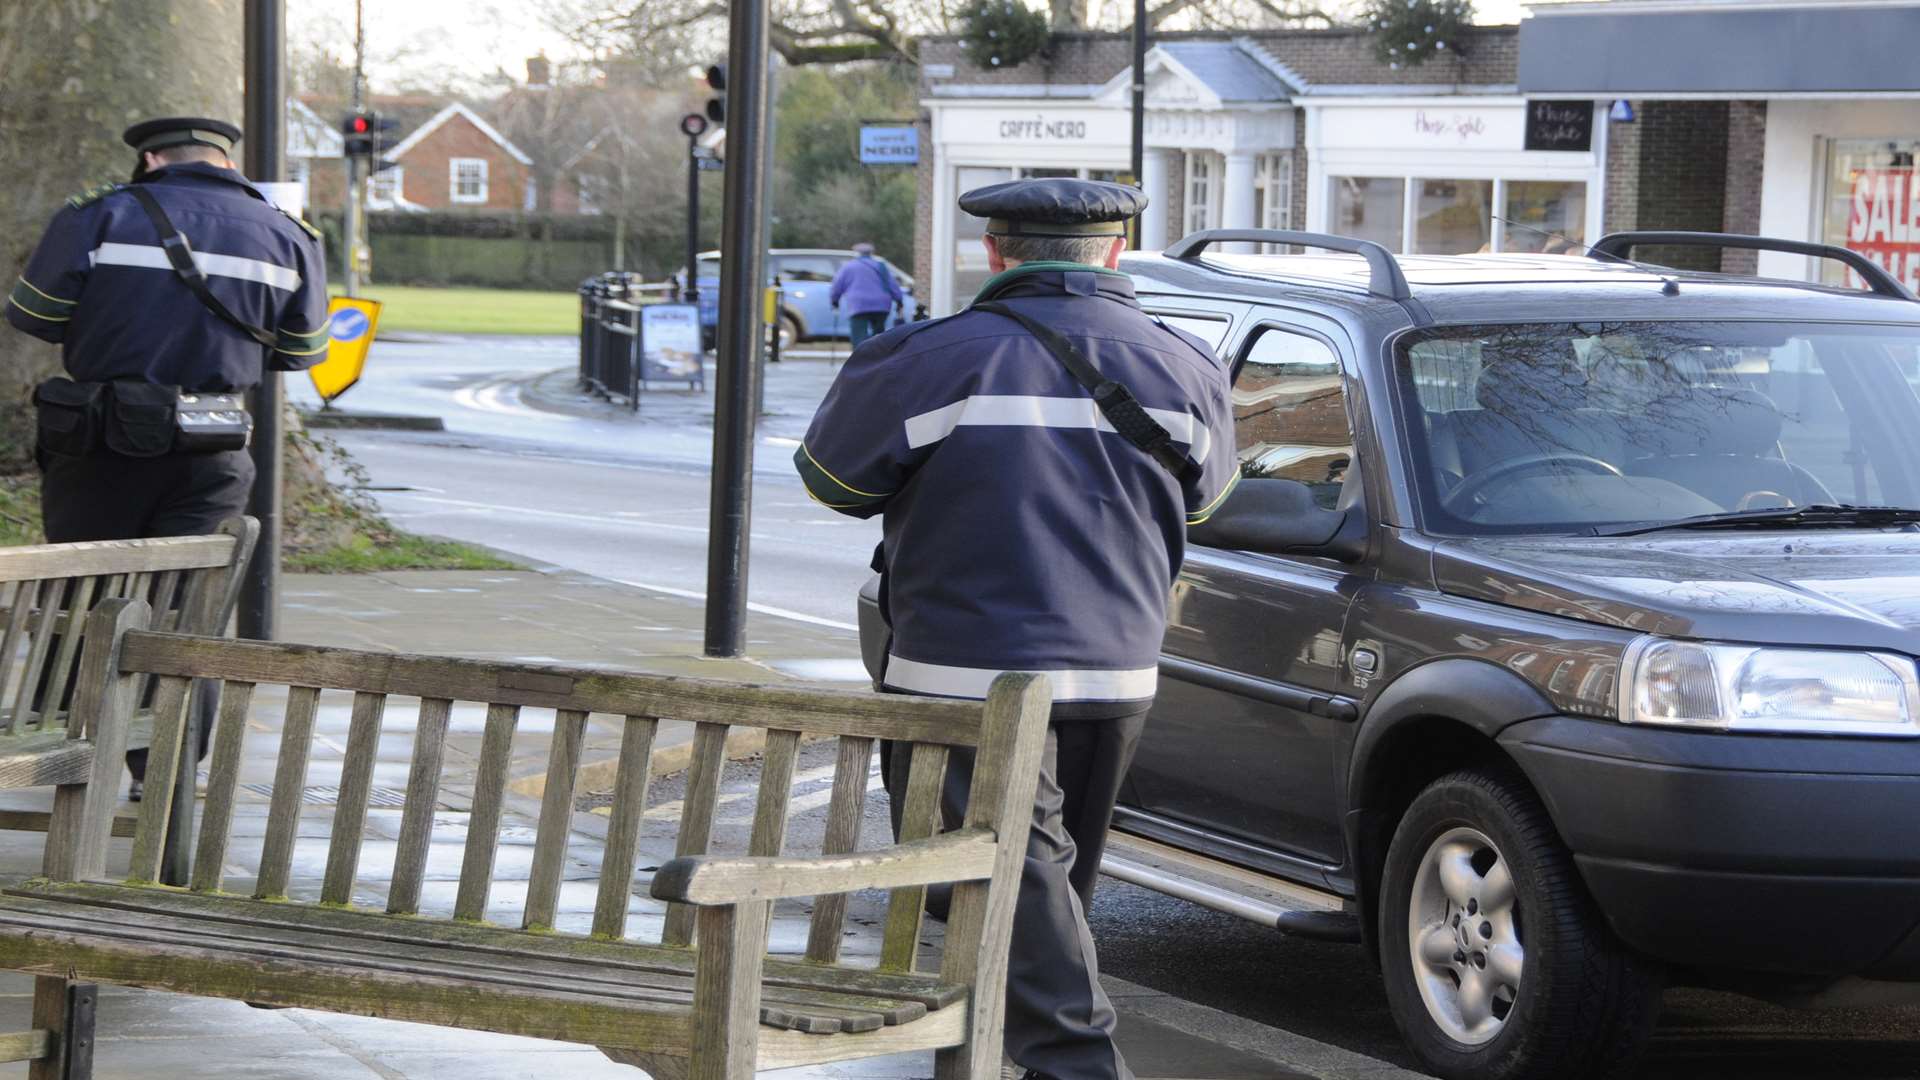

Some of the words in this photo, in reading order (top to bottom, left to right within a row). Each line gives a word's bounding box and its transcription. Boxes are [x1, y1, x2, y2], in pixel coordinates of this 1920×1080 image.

[1045, 120, 1086, 138] NERO
[864, 145, 915, 156] NERO
[1851, 173, 1920, 242] SALE
[1353, 676, 1368, 689] ES
